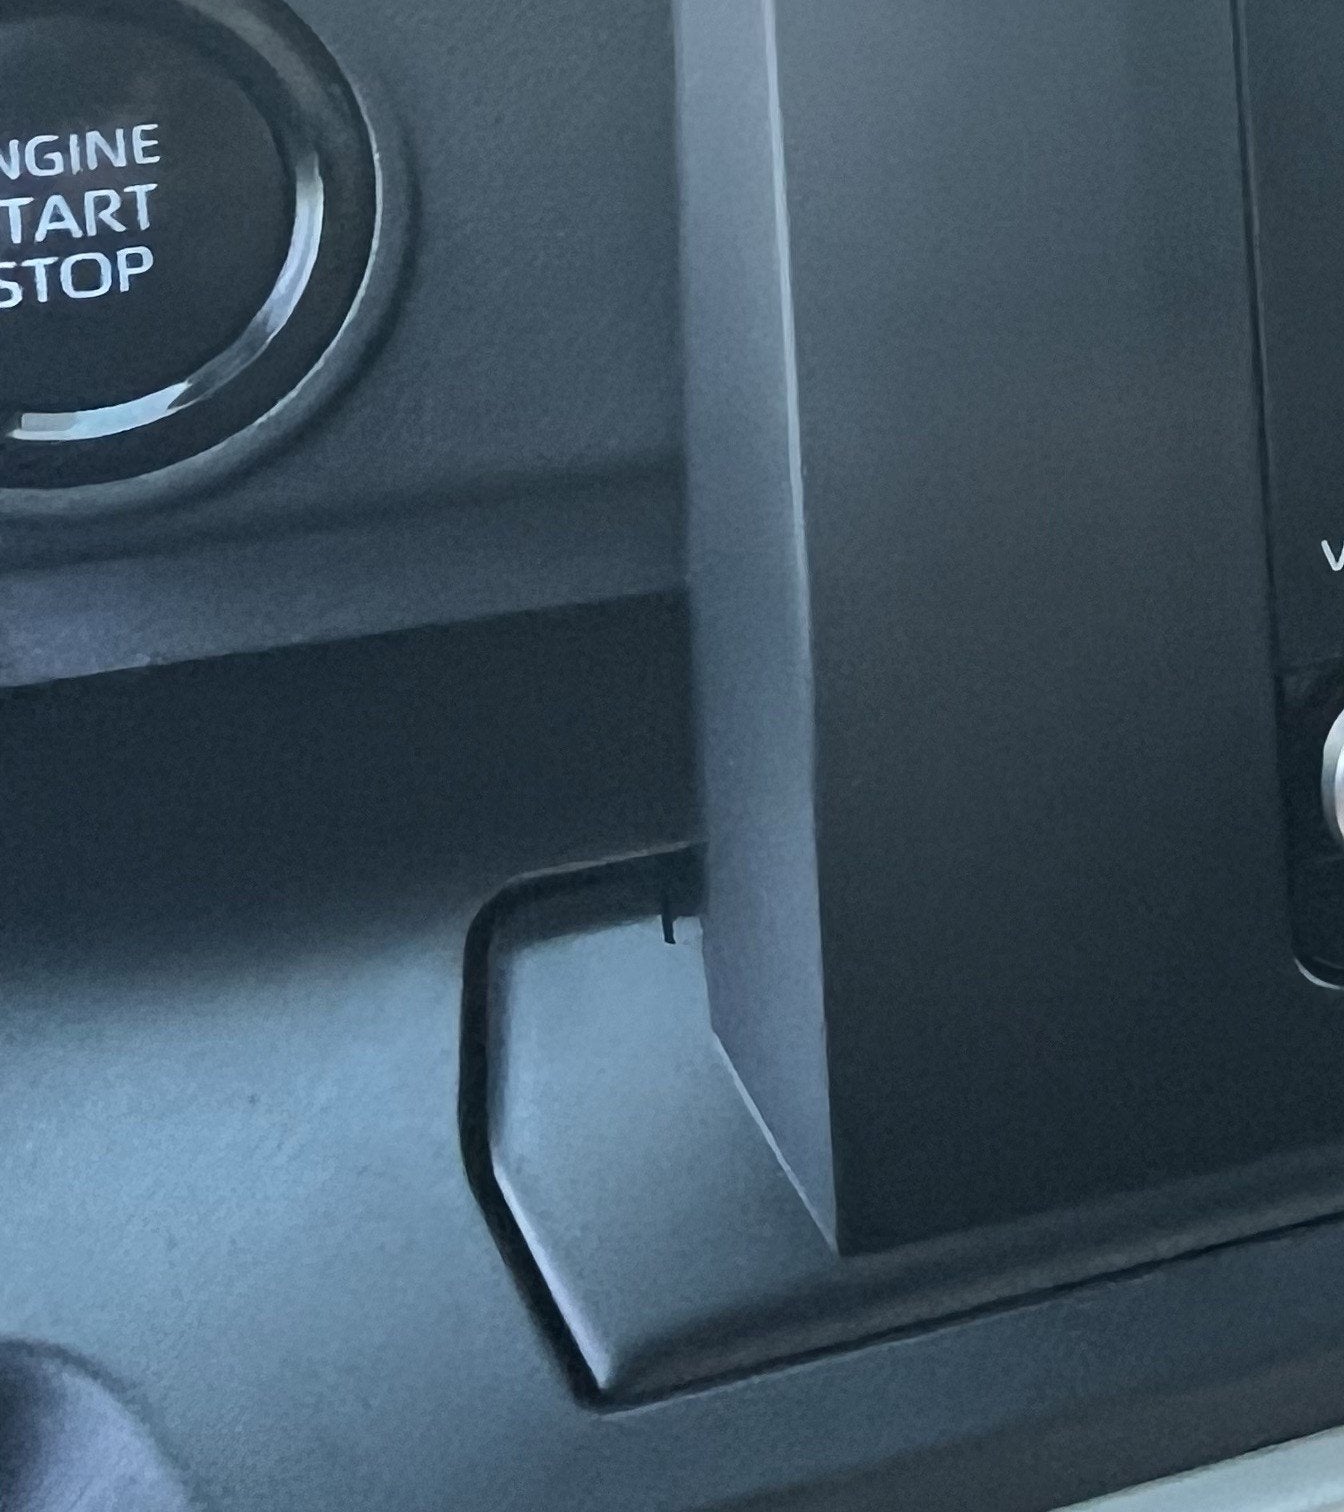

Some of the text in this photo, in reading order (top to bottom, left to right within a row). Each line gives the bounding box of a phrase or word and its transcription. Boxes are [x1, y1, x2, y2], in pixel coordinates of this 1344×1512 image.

[0, 123, 161, 181] NGINE
[0, 183, 158, 244] TART
[0, 245, 154, 309] STOP
